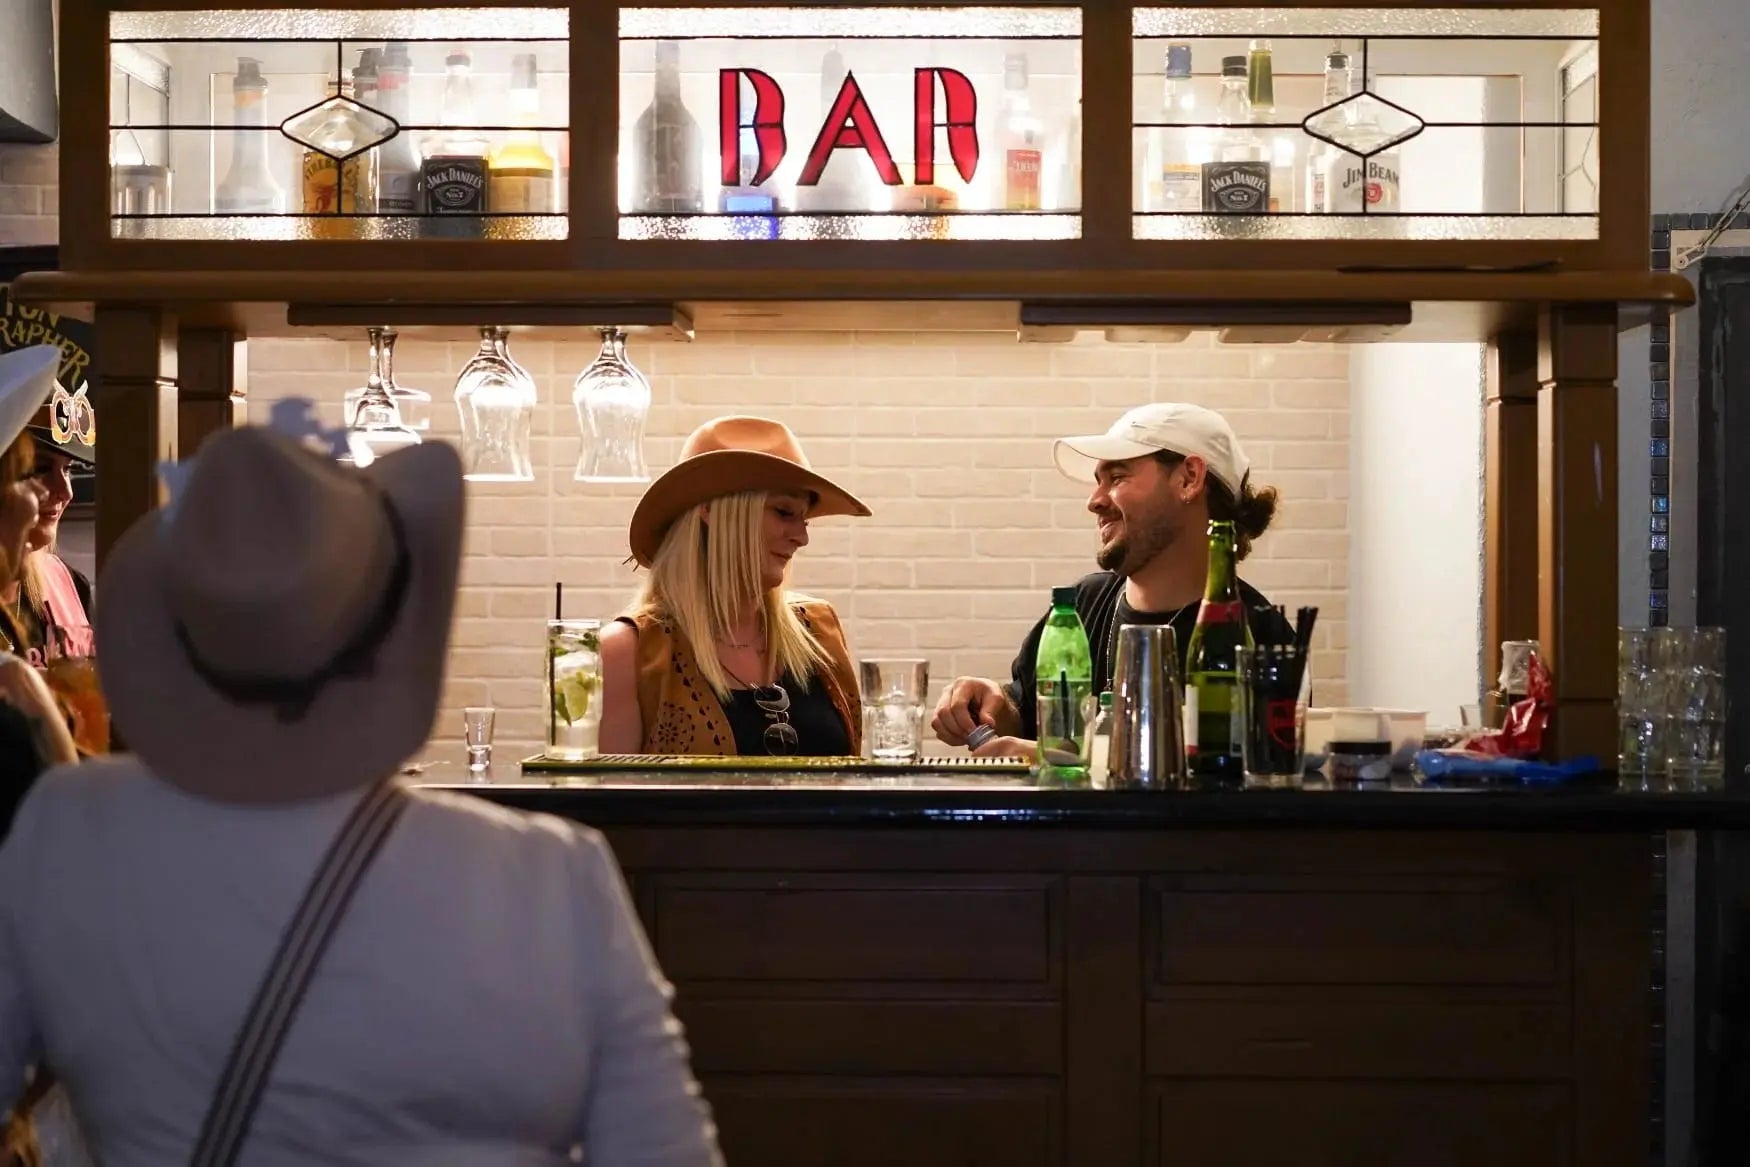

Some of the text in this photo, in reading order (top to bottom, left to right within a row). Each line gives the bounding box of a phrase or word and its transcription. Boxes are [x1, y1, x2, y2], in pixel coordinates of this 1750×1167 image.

[719, 67, 980, 186] BAR
[426, 172, 449, 189] JACK
[1210, 175, 1233, 192] JACK
